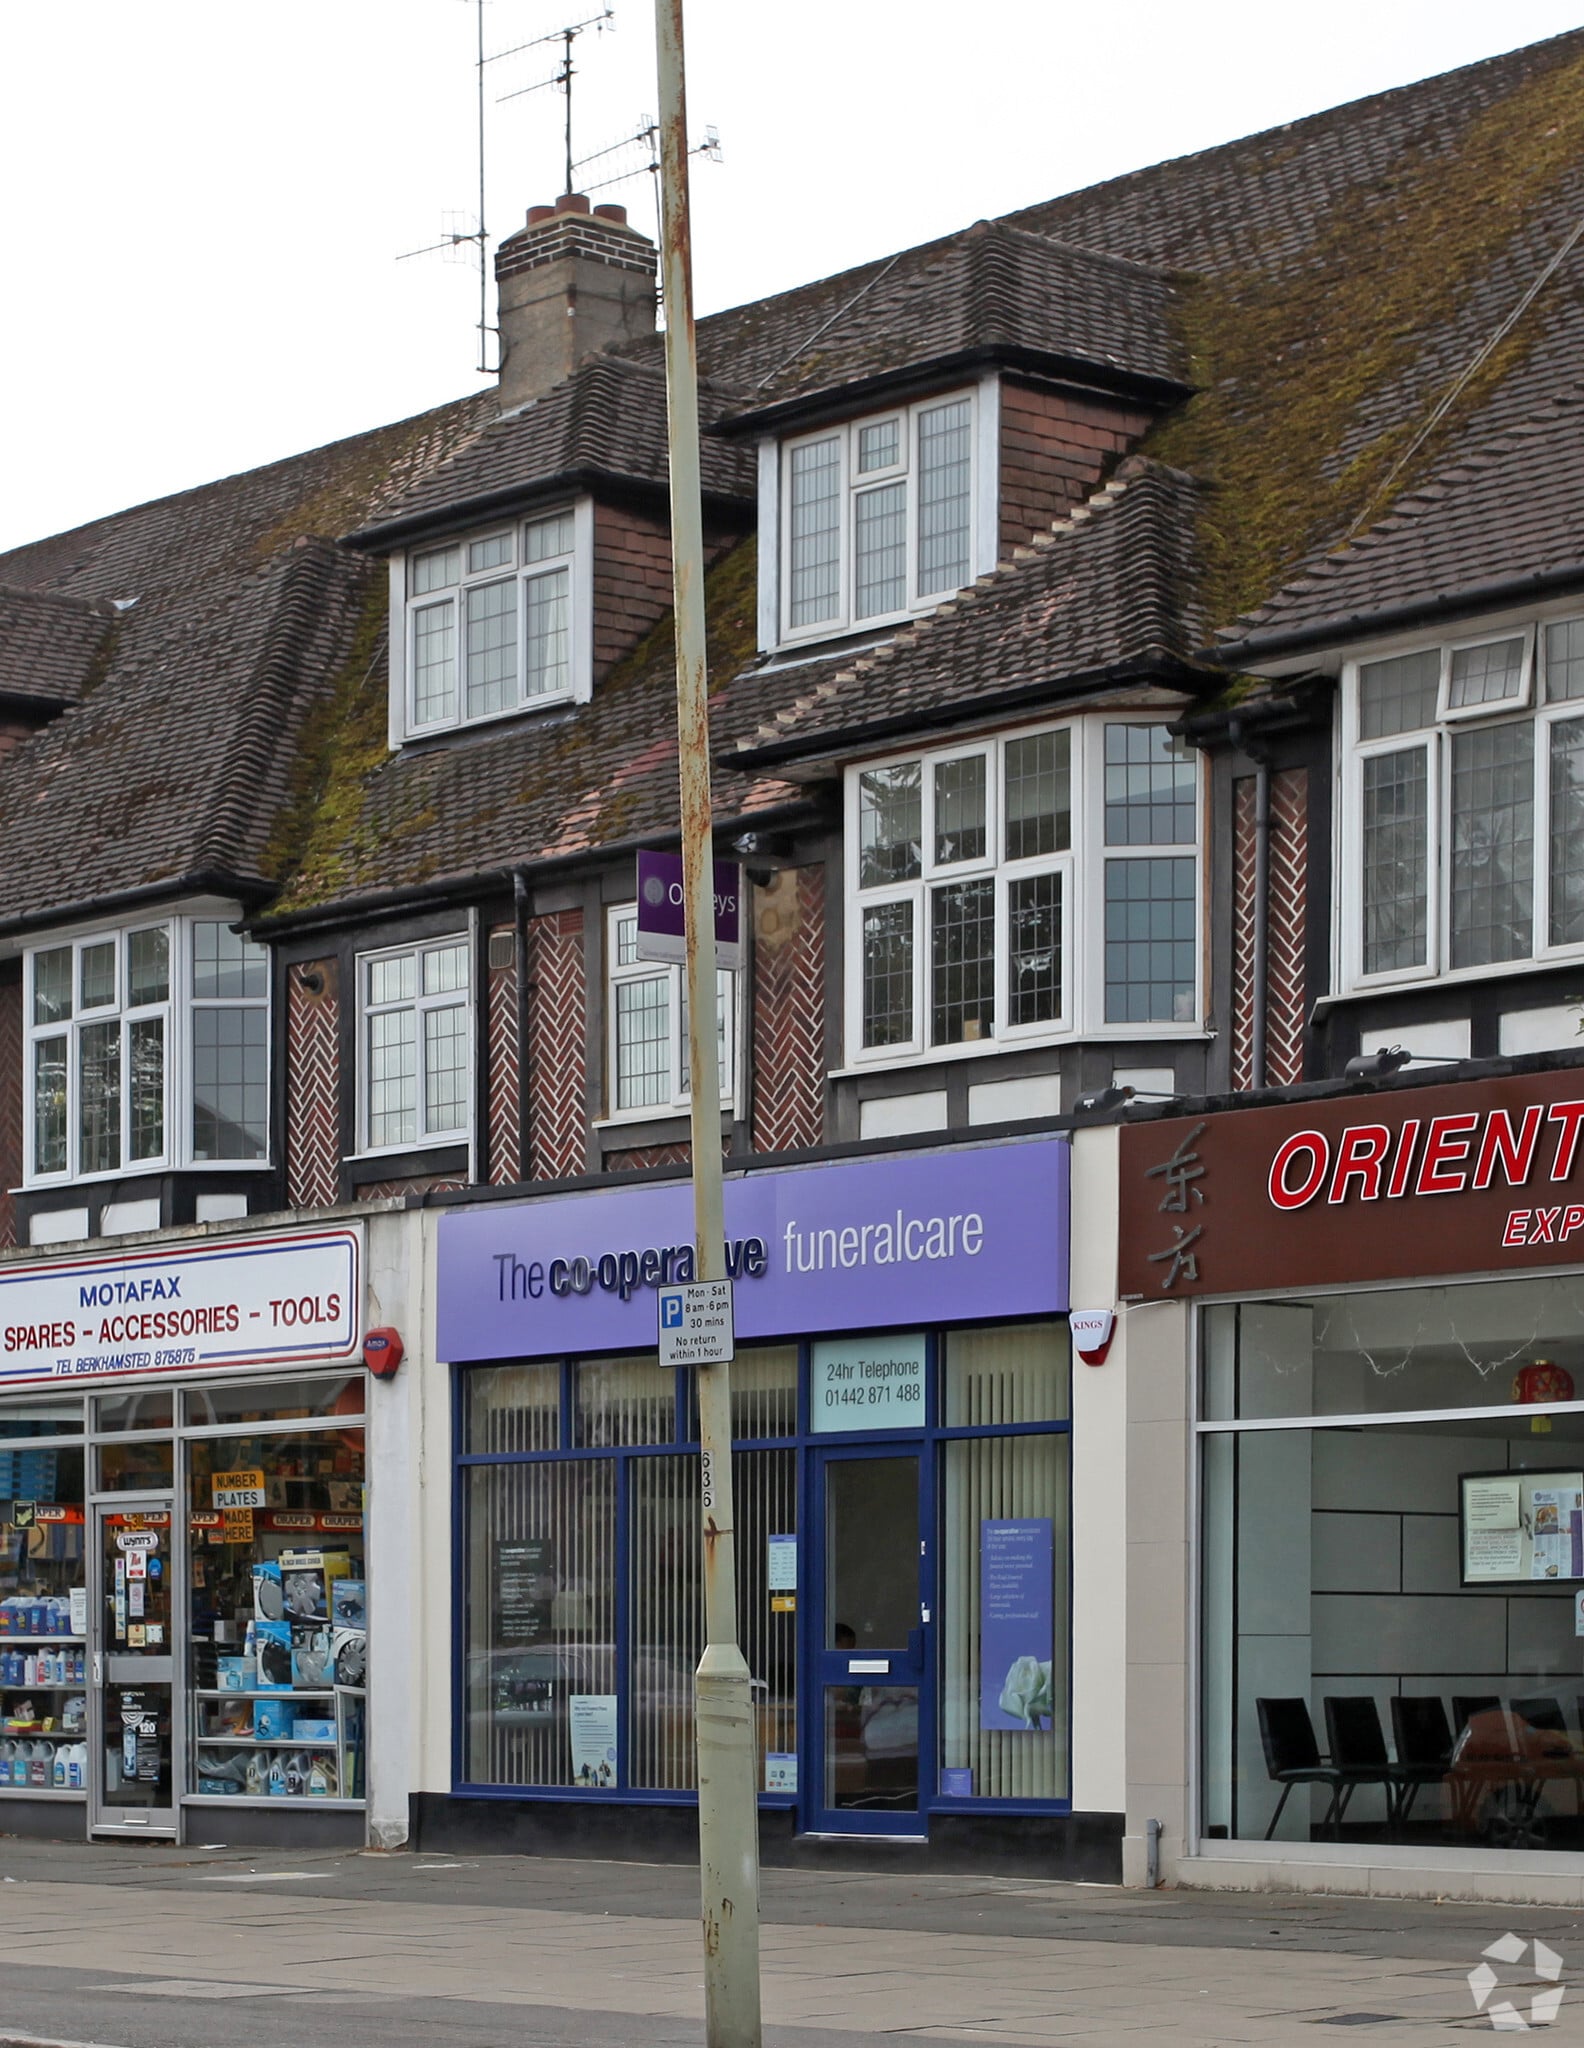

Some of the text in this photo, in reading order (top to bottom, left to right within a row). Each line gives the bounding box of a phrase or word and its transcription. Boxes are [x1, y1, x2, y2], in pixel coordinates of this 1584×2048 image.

[492, 1210, 984, 1301] The co-operave funeralcare
[79, 1276, 182, 1308] MOTAFAX
[687, 1289, 705, 1299] Mon
[711, 1285, 726, 1297] Sat
[4, 1321, 76, 1352] SPARES
[99, 1304, 240, 1344] ACCESSORIES
[269, 1293, 341, 1327] TOOLS
[690, 1317, 725, 1328] 30 mins
[1073, 1320, 1104, 1330] KINGS
[676, 1335, 717, 1347] No return
[669, 1348, 696, 1360] within
[703, 1347, 723, 1357] hour
[56, 1359, 73, 1375] TEL
[76, 1352, 152, 1373] BERKHAMSTED
[826, 1360, 920, 1382] 24hr Telephone
[825, 1382, 921, 1408] 01442 871 488
[215, 1472, 257, 1489] NUMBER
[216, 1490, 258, 1507] PLATES
[224, 1508, 251, 1523] MADE
[225, 1525, 252, 1540] HERE
